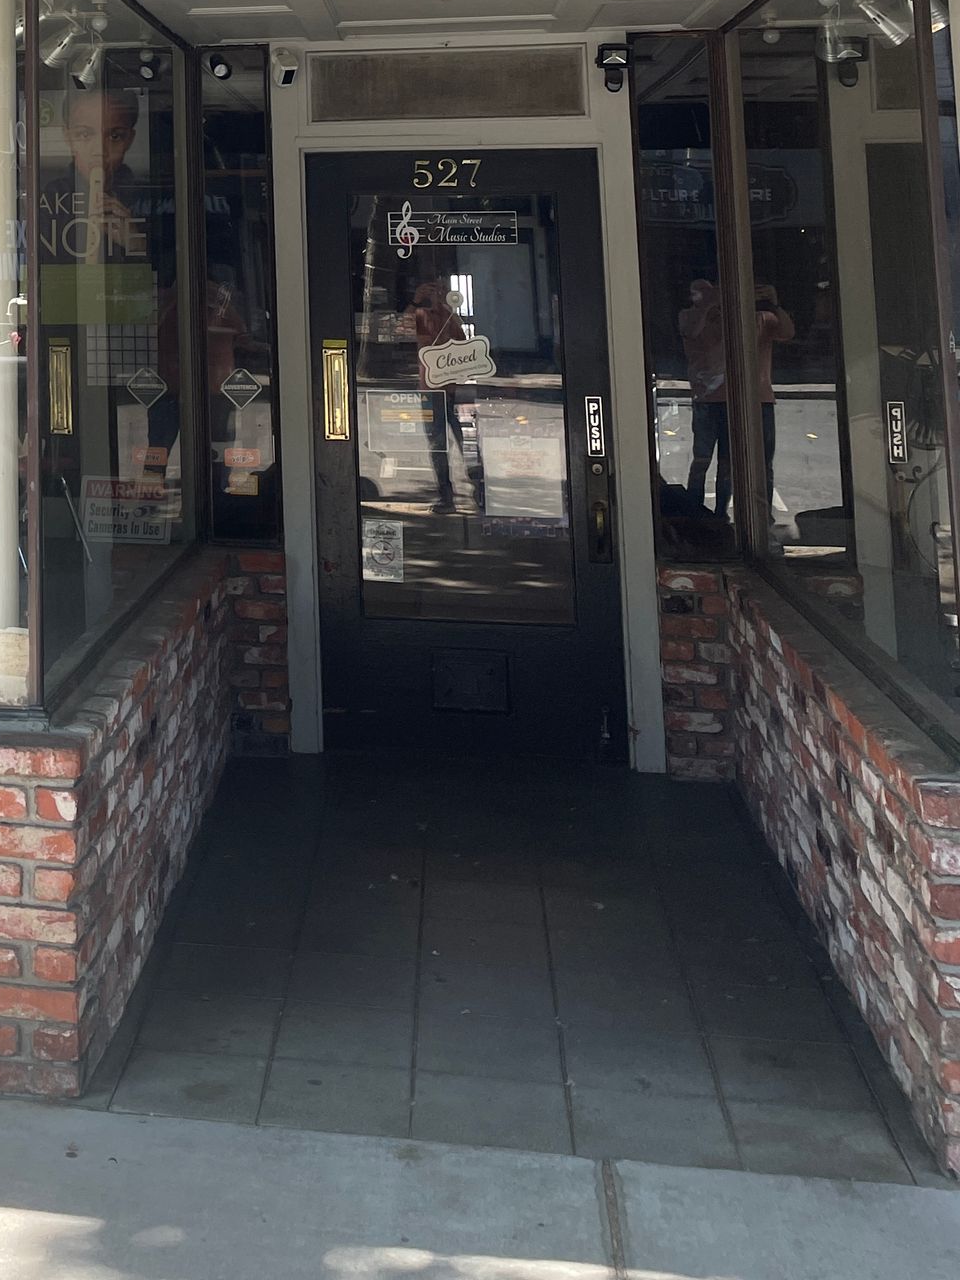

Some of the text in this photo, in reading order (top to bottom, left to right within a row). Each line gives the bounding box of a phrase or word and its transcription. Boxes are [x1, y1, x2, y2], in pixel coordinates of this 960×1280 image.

[413, 158, 482, 189] 527
[427, 213, 483, 225] Main Street
[40, 218, 147, 258] NOTE
[428, 224, 507, 242] Music Studios
[436, 349, 478, 369] Closed
[390, 393, 422, 404] OPEN
[588, 402, 601, 451] PUSH
[90, 483, 165, 499] WARNING
[89, 502, 130, 520] Security
[87, 519, 161, 536] Cameras In Use
